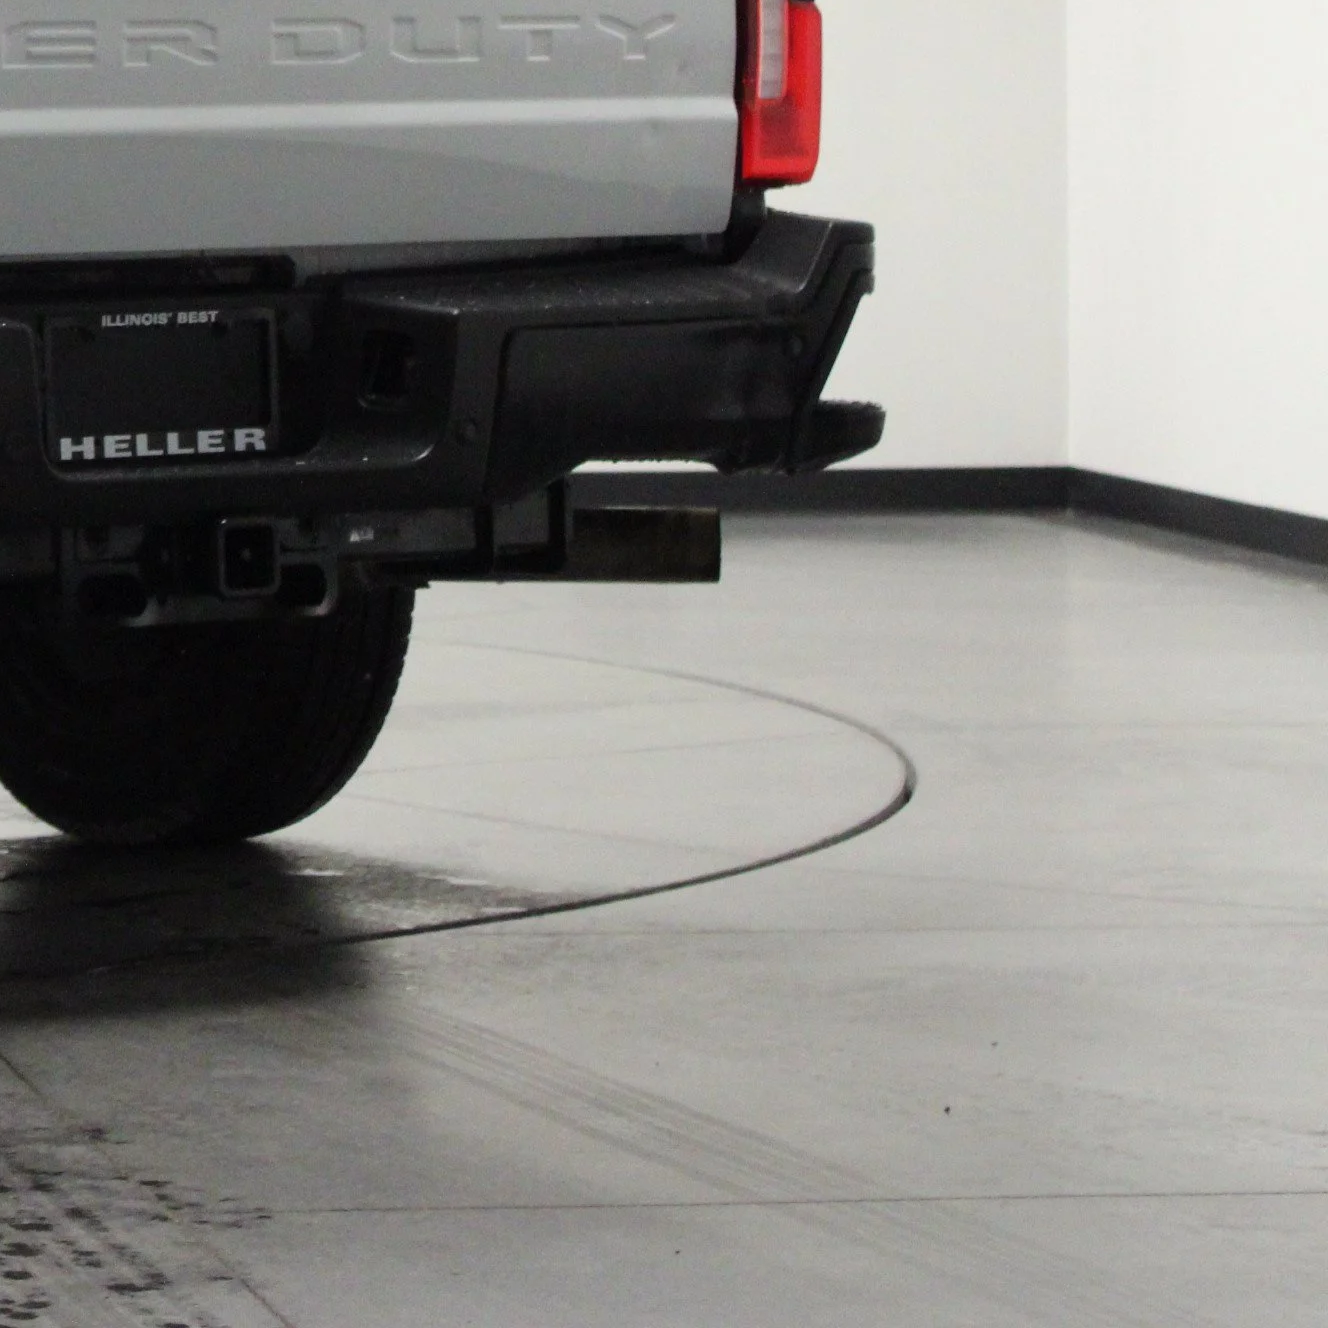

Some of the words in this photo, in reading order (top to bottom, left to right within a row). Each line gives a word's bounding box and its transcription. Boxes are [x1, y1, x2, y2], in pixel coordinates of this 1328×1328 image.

[270, 12, 679, 65] DUTY
[176, 309, 220, 325] BEST
[59, 427, 267, 461] HELLER
